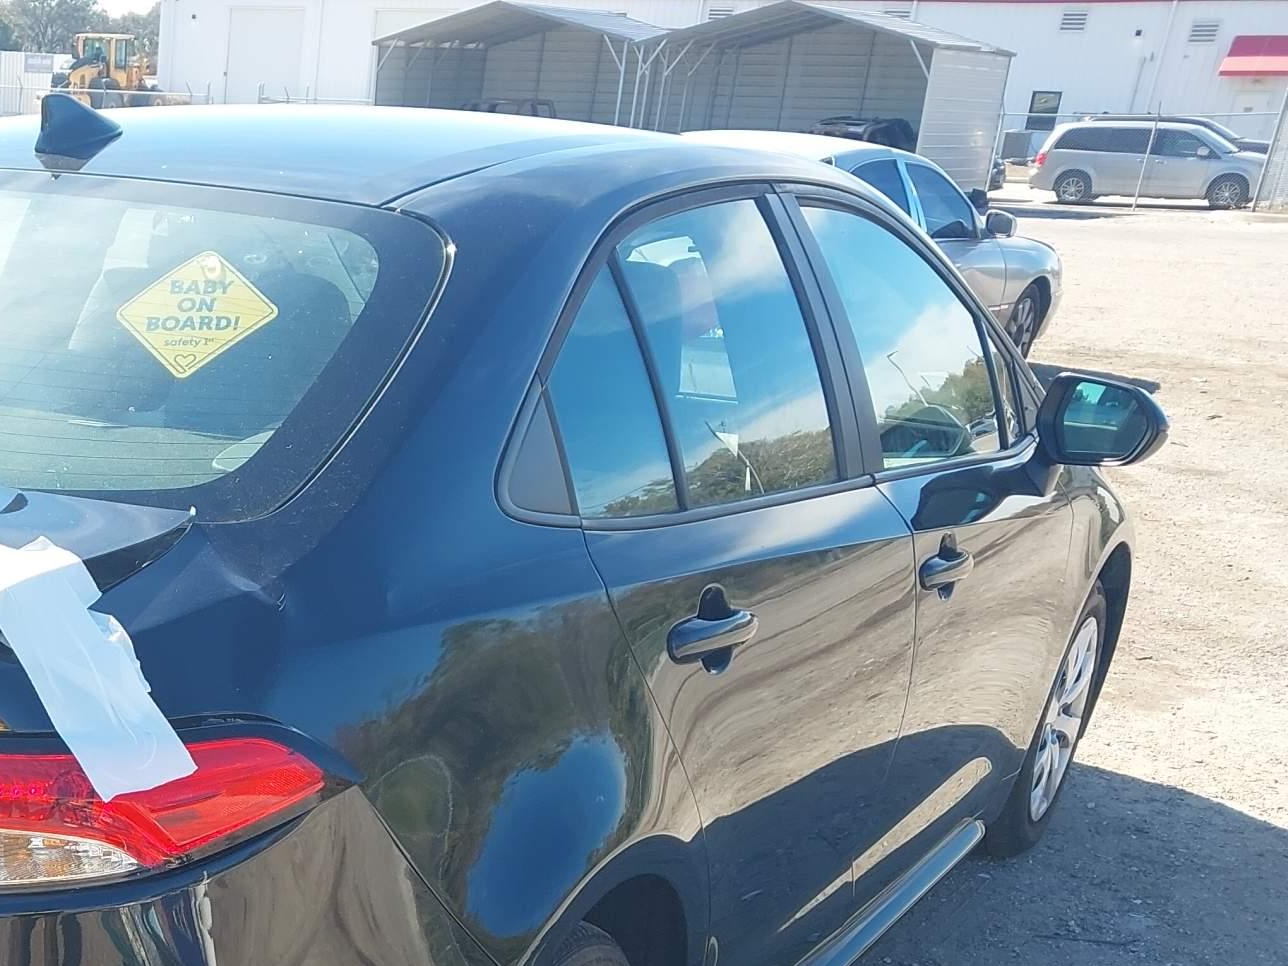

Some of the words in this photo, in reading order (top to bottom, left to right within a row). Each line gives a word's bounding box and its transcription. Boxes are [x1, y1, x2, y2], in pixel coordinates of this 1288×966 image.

[170, 279, 235, 295] BABY
[177, 297, 217, 313] ON
[145, 316, 241, 332] BOARD!
[163, 337, 201, 348] safety
